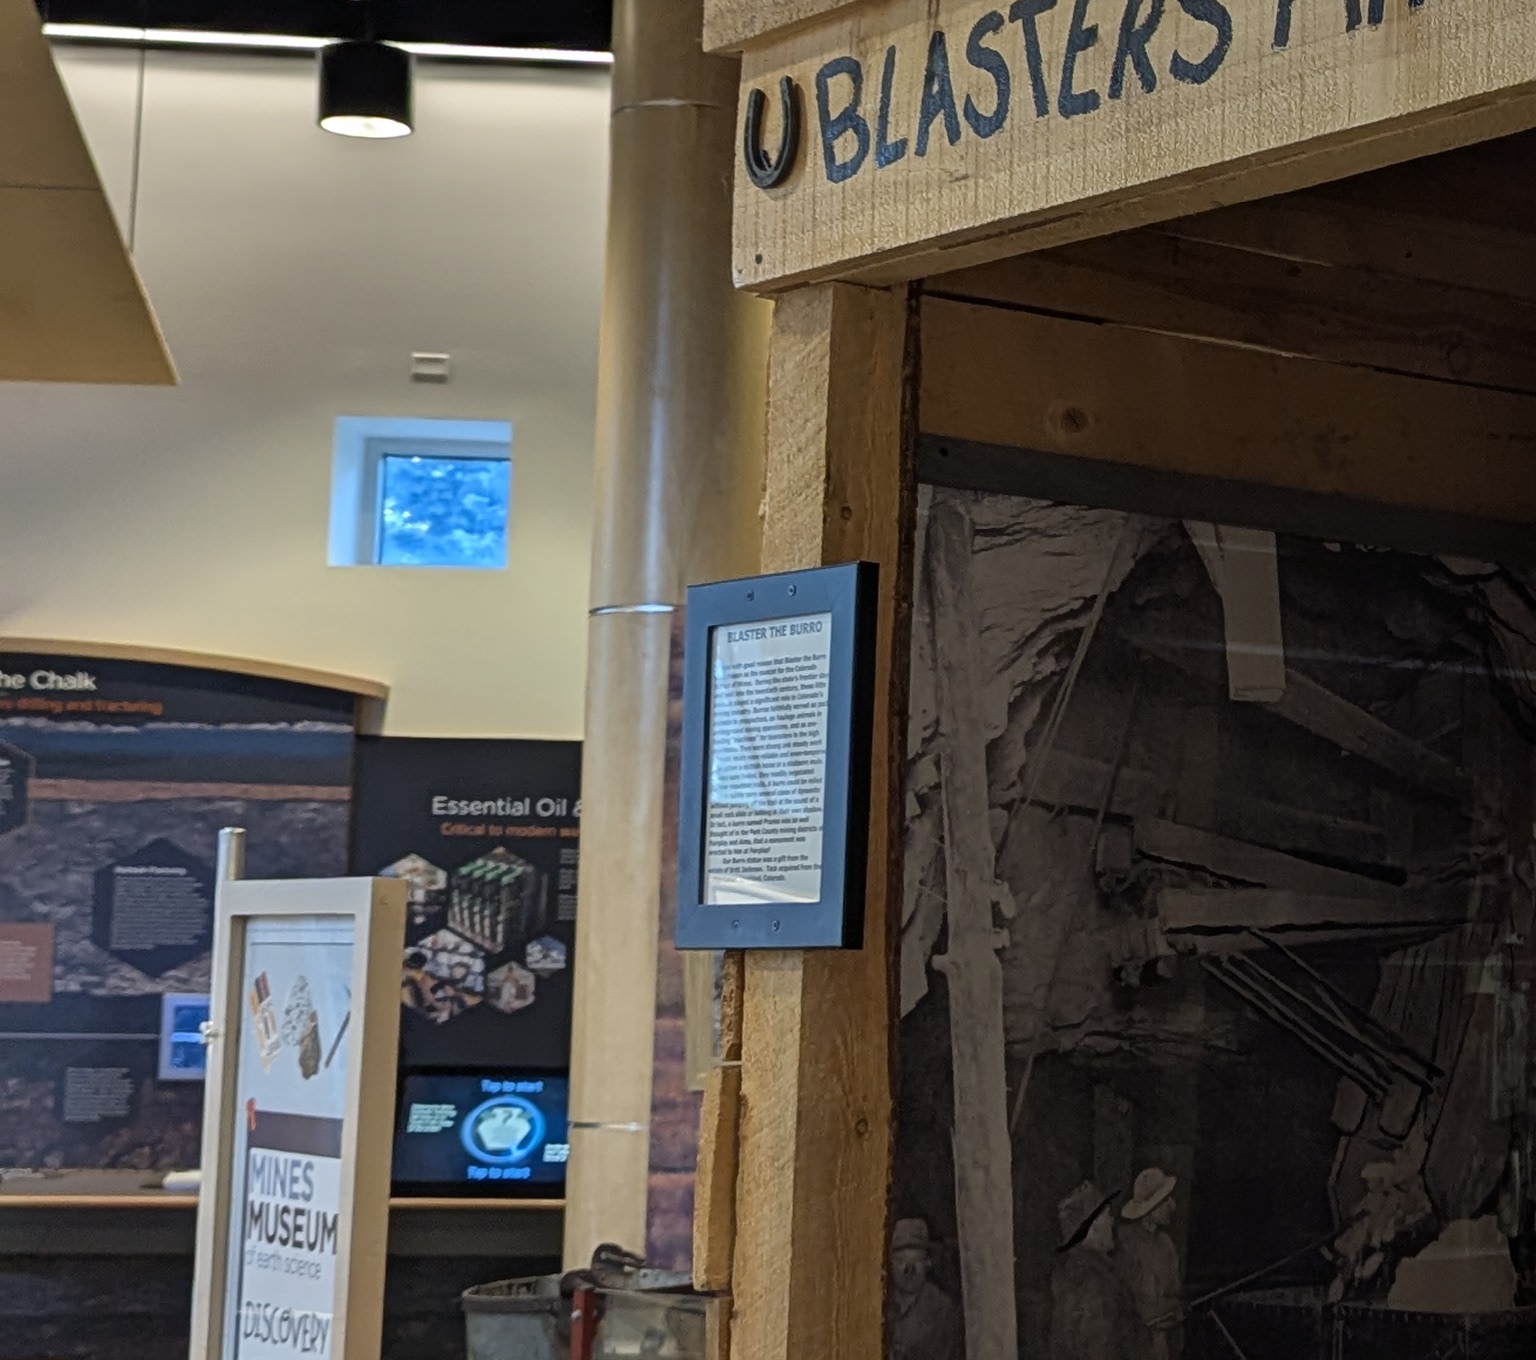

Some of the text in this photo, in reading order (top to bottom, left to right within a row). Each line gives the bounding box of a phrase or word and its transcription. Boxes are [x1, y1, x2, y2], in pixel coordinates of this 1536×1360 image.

[727, 621, 822, 643] BLASTER THE BURRO
[0, 670, 98, 690] he Chalk
[432, 796, 530, 816] Essential
[535, 797, 567, 817] Oil
[488, 825, 503, 837] to
[505, 825, 557, 838] modern
[251, 1153, 315, 1202] MINES
[247, 1199, 340, 1256] MUSEUM
[246, 1245, 256, 1265] of
[284, 1256, 322, 1280] science
[244, 1300, 331, 1355] DISCOVERY
